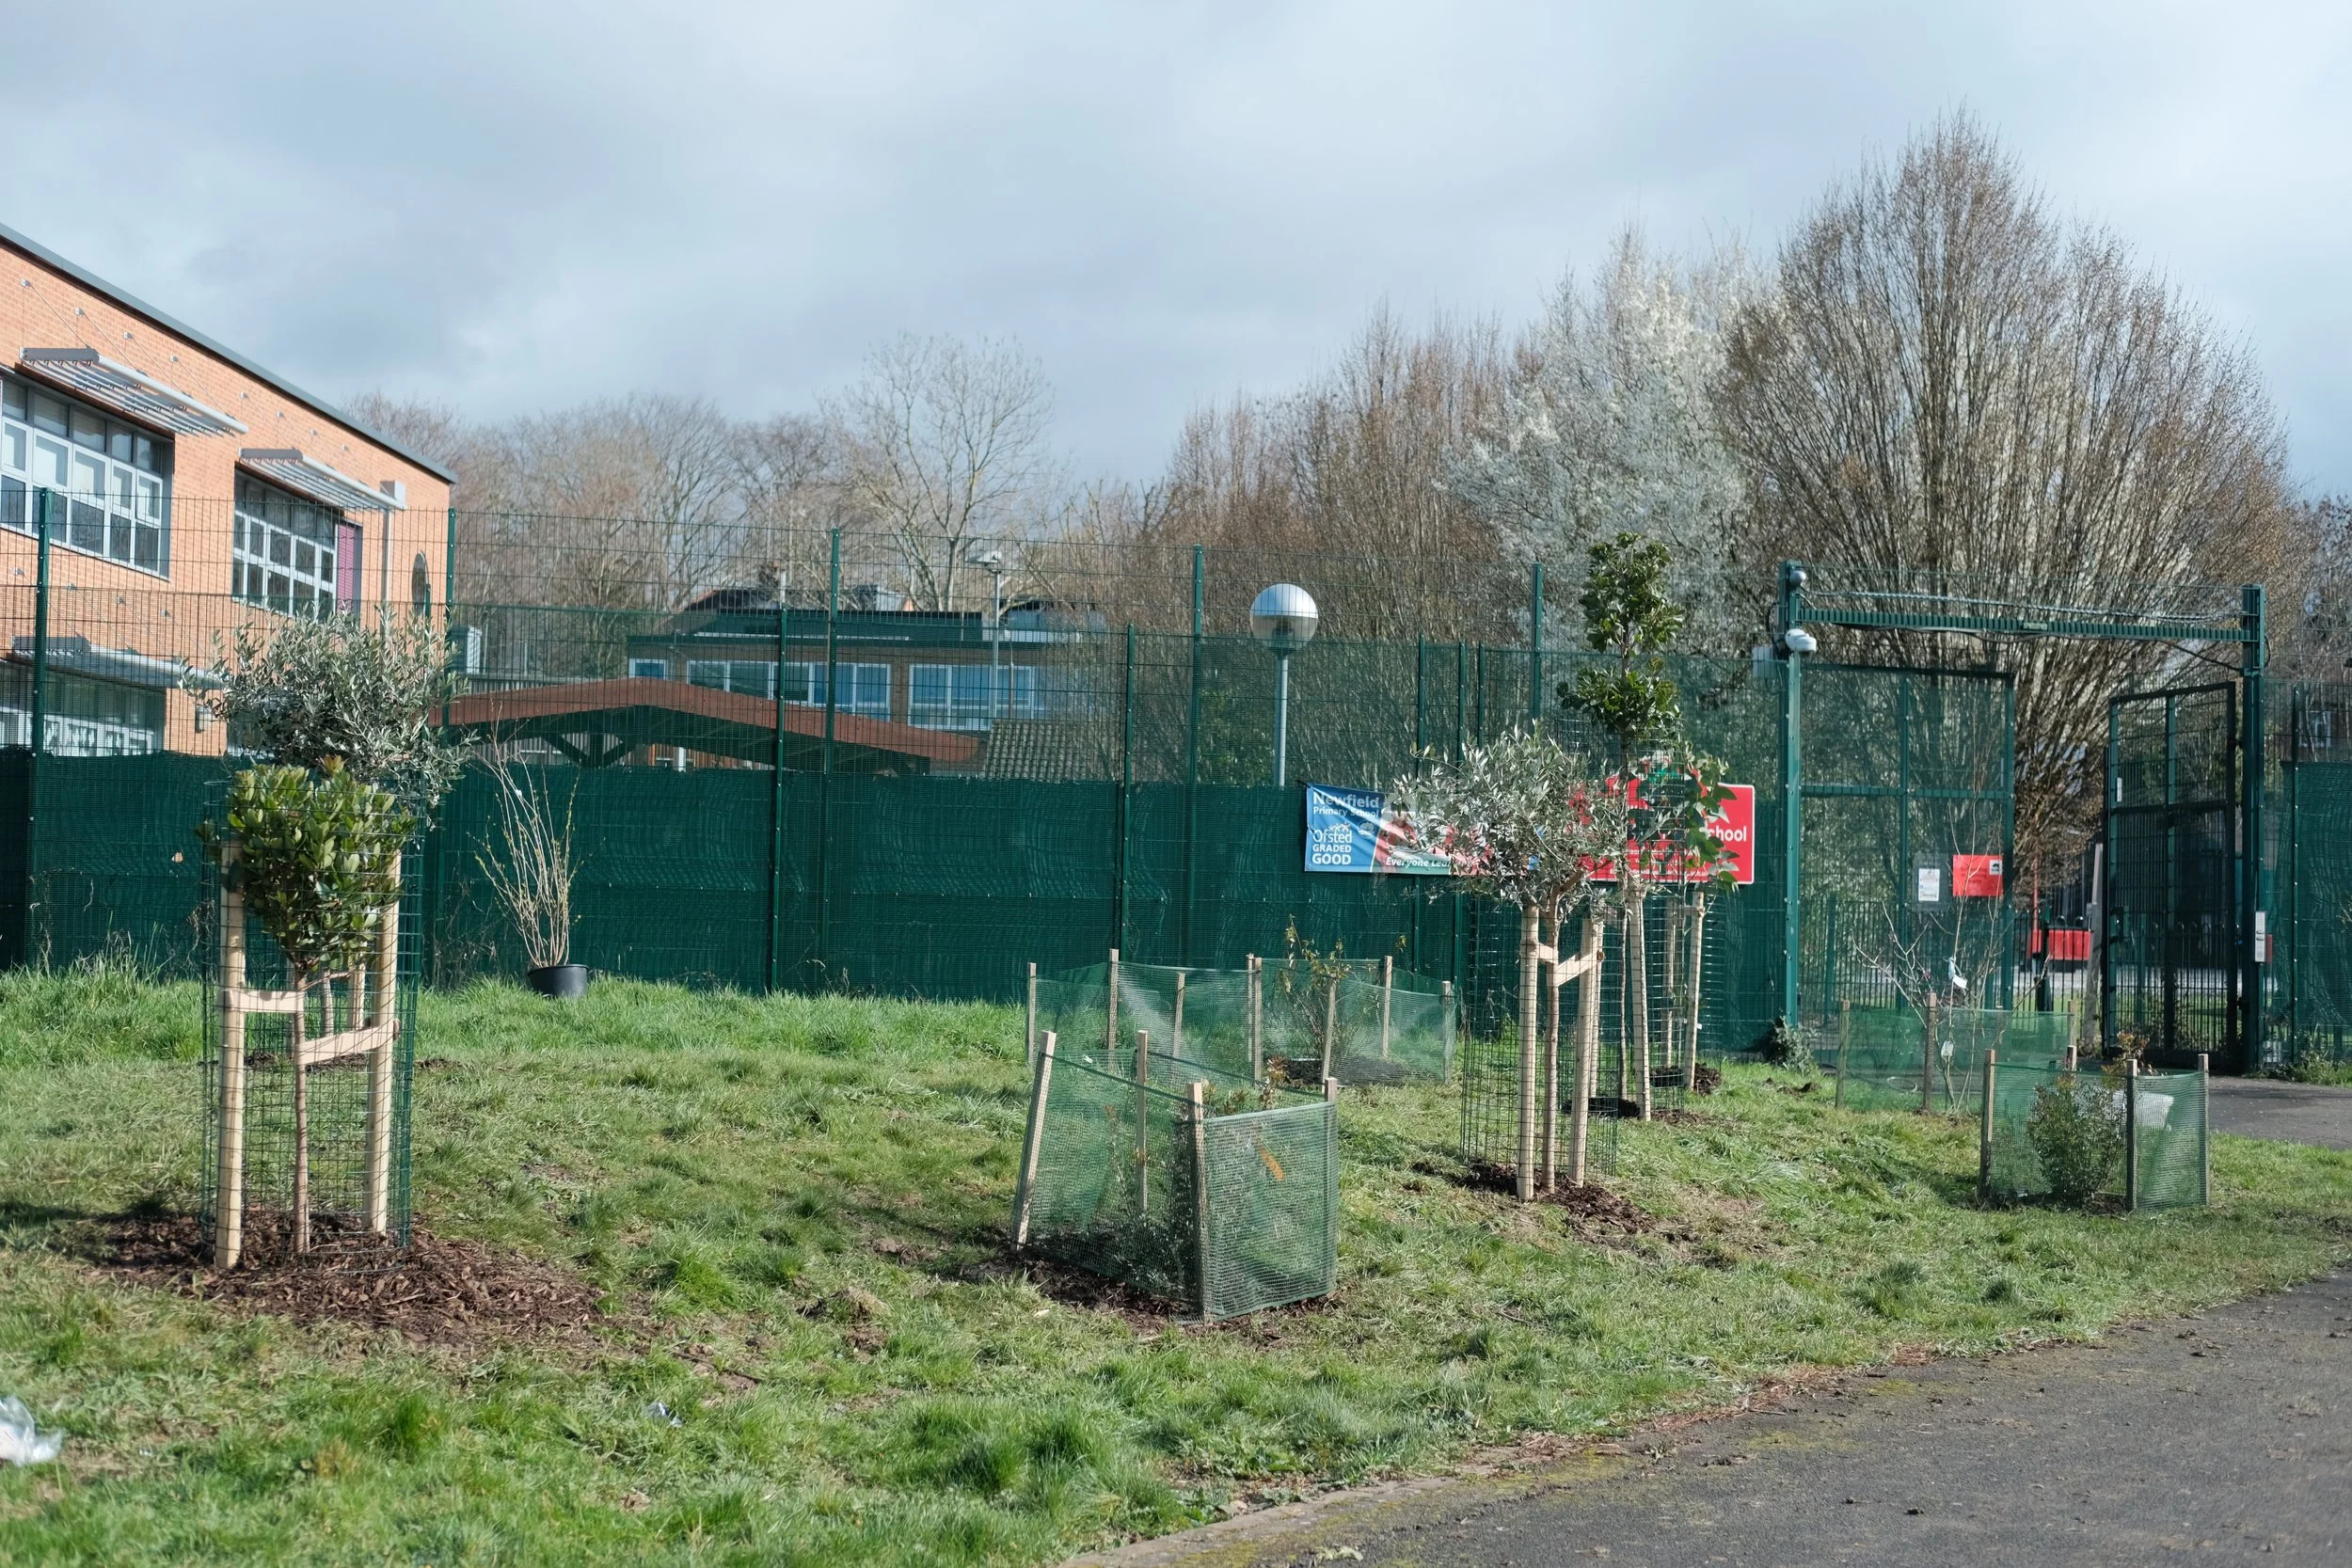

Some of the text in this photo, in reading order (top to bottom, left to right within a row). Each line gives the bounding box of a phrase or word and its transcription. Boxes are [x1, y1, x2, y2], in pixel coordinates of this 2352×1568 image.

[1312, 791, 1379, 808] Newfield
[1313, 806, 1379, 818] Primary School
[1313, 829, 1352, 843] Ofsted
[1312, 845, 1352, 853] GRADED
[1312, 853, 1352, 865] GOOD
[1386, 857, 1429, 869] Everyone
